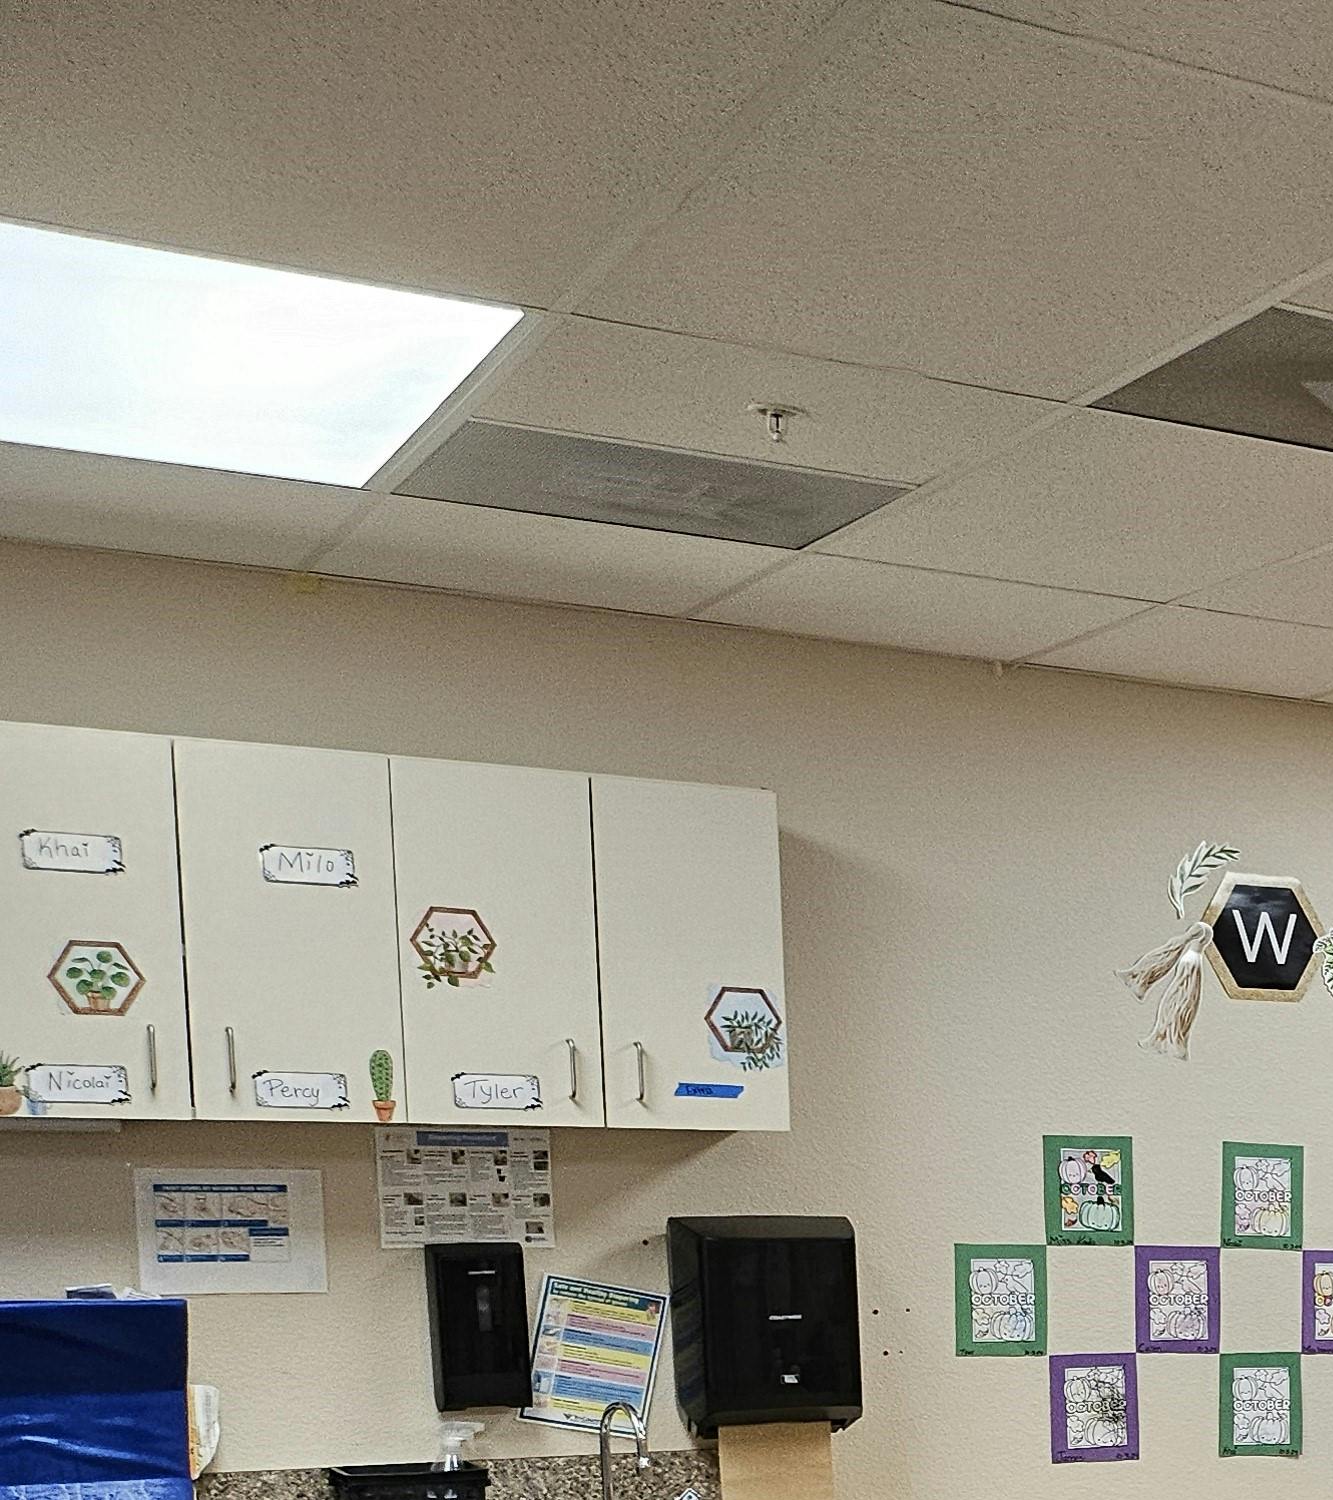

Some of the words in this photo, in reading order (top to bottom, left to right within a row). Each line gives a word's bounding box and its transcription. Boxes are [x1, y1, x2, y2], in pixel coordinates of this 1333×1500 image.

[37, 838, 89, 859] Khai
[278, 850, 335, 873] Milo
[48, 1070, 112, 1091] Nicolai
[265, 1078, 321, 1107] Percy
[463, 1078, 524, 1105] Tyler
[1060, 1183, 1121, 1195] OCTOBER
[1235, 1190, 1292, 1202] OCTOBER
[971, 1294, 1036, 1306] OCTOBER
[1149, 1294, 1209, 1306] OCTOBER
[1066, 1399, 1127, 1414] OCTOBER
[1233, 1399, 1291, 1411] OCTOBER
